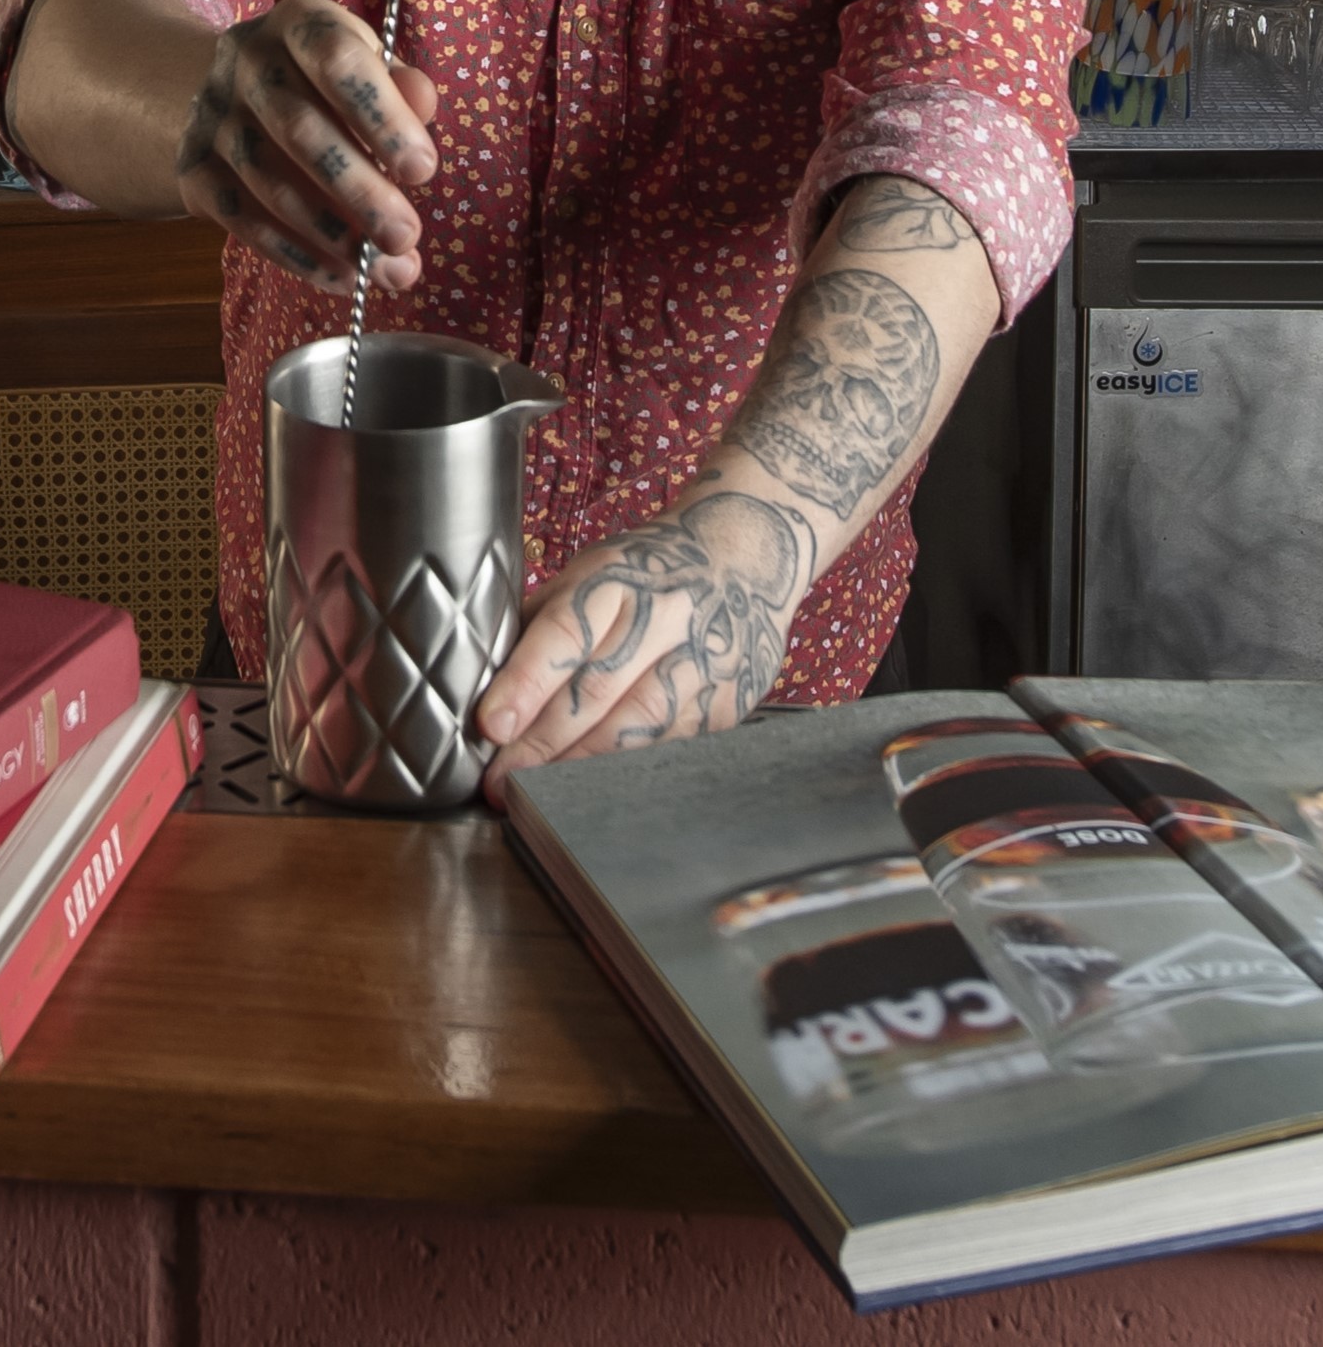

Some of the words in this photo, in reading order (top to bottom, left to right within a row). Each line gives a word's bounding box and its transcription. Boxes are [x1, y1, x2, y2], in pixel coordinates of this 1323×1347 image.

[1095, 371, 1199, 396] easyICE
[1057, 828, 1148, 848] DOSE
[62, 824, 125, 939] SHERRY
